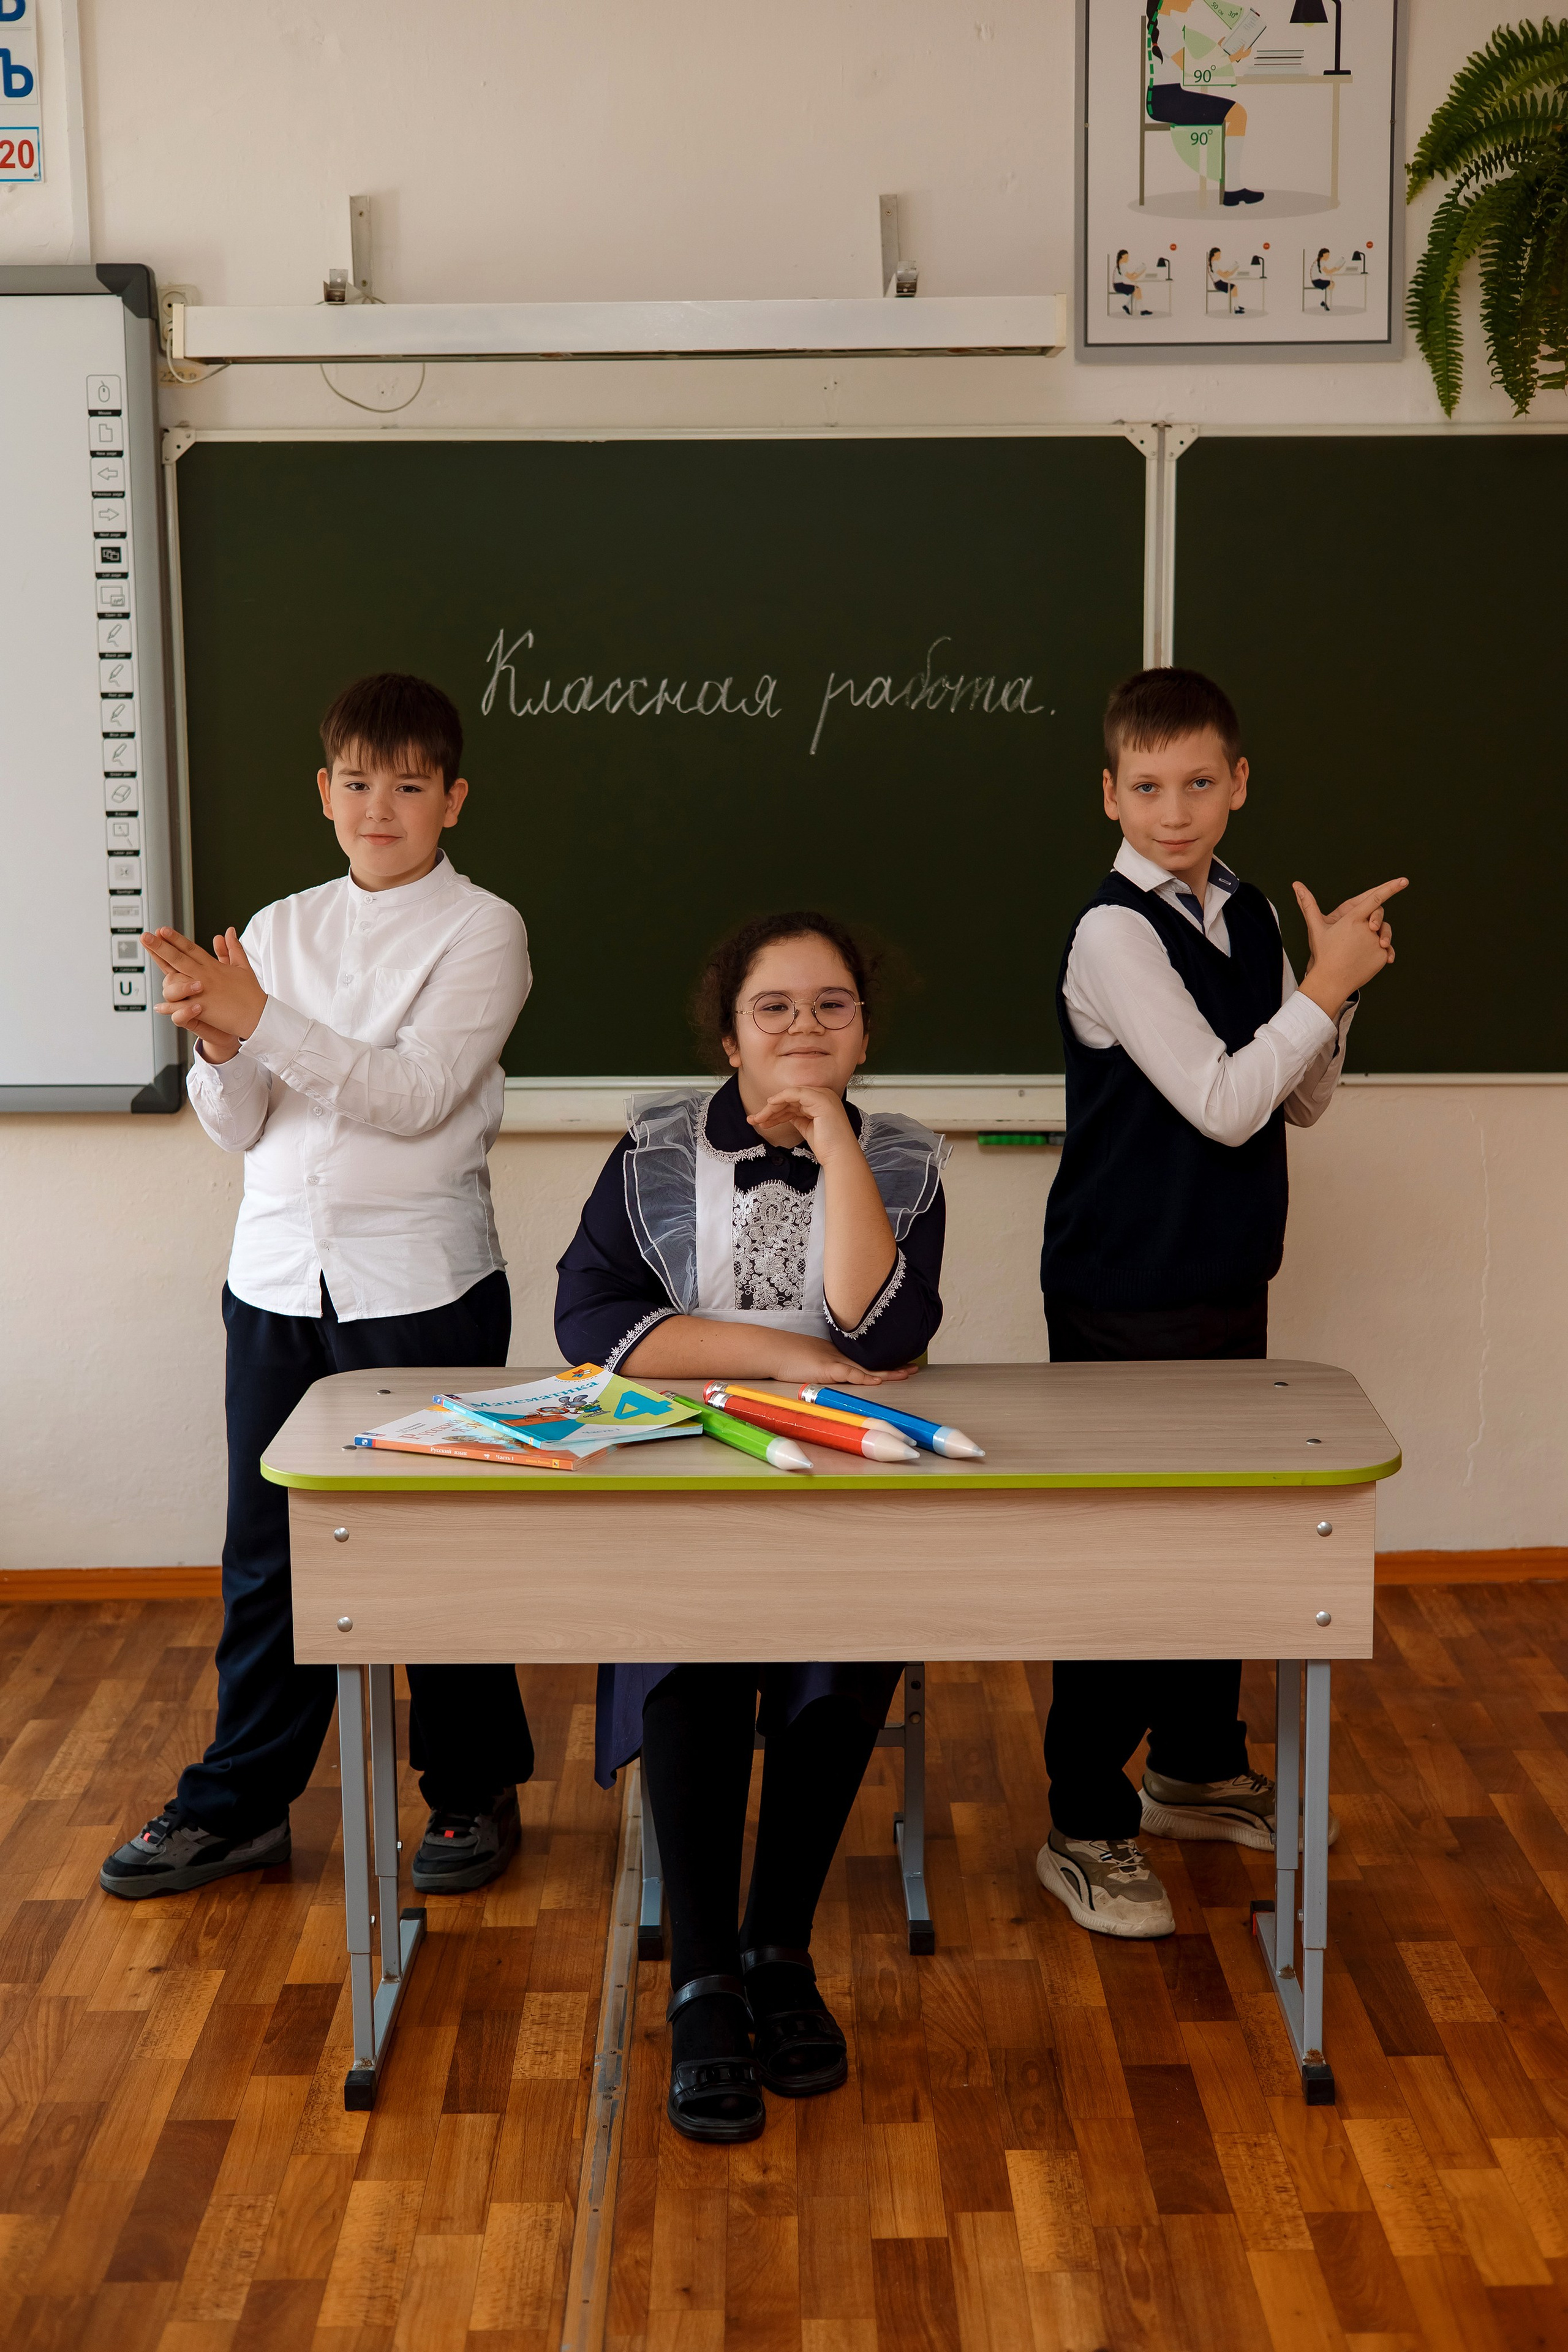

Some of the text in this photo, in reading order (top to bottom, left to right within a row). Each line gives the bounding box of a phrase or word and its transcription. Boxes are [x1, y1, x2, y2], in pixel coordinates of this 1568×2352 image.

[0, 140, 34, 169] 20
[481, 628, 1057, 755] Классная работа.
[470, 1381, 600, 1408] Математика
[613, 1390, 674, 1420] 4
